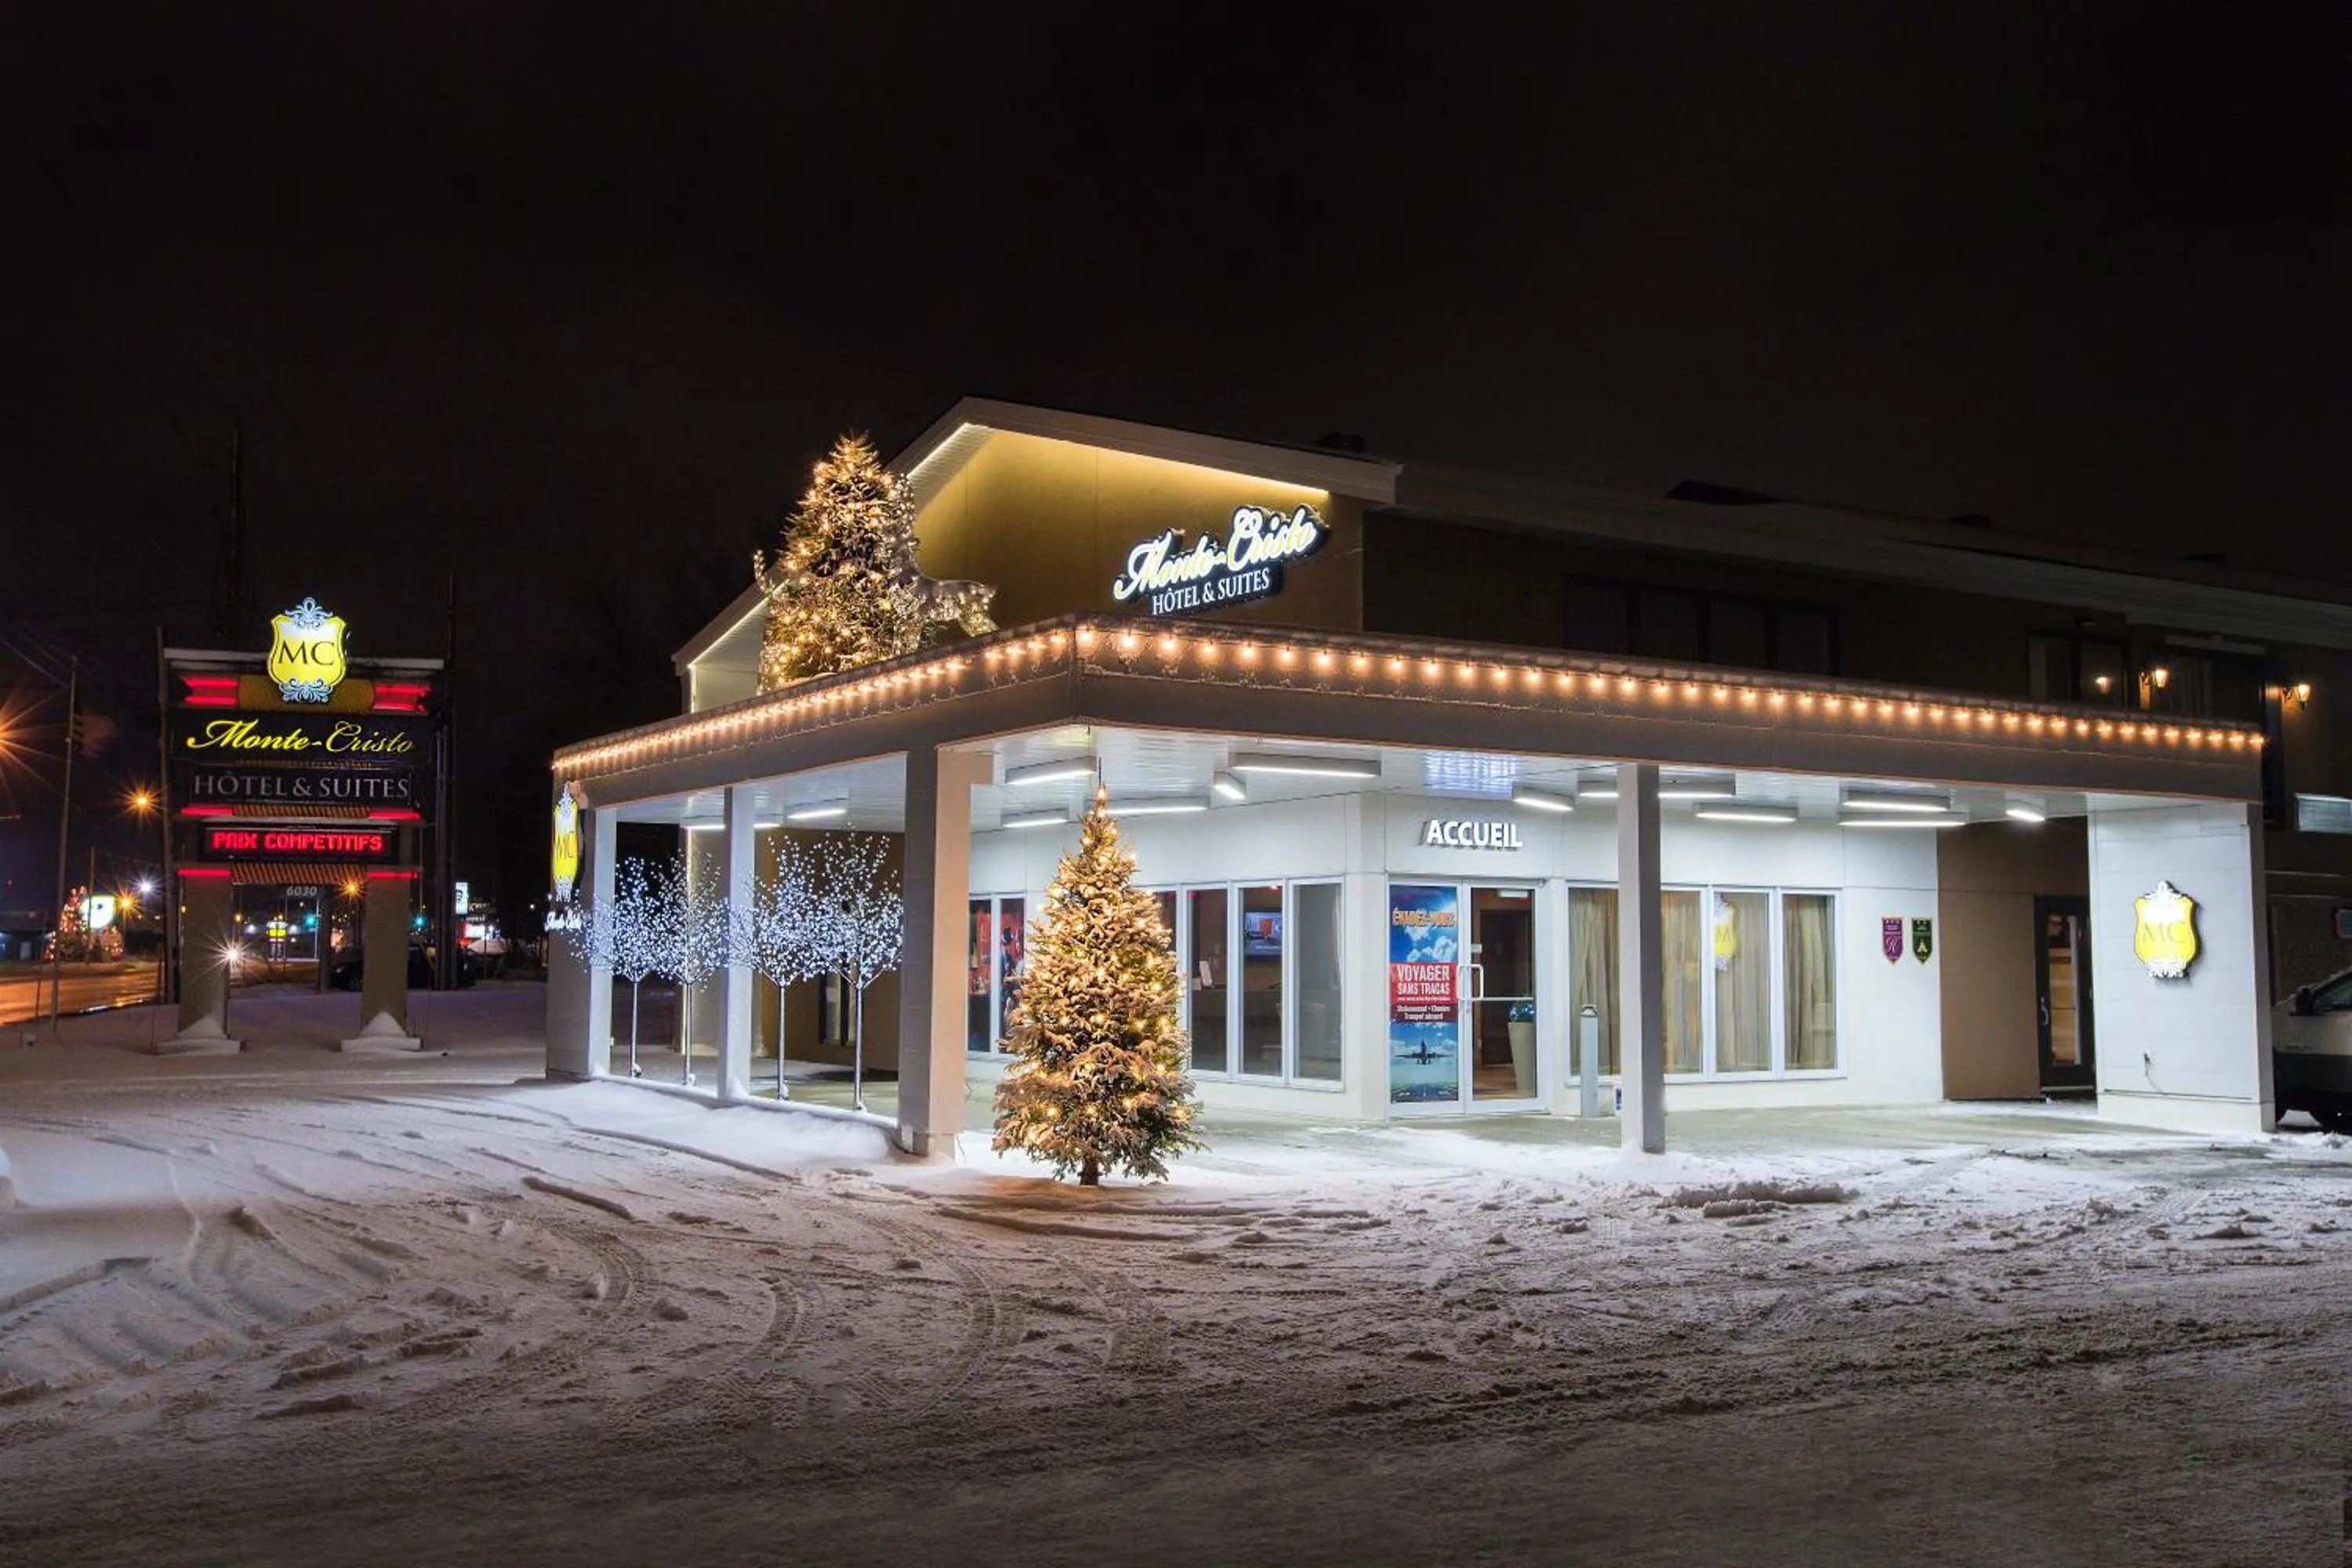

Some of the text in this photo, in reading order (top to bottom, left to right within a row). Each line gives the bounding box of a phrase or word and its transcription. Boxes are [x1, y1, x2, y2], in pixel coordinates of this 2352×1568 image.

[1152, 568, 1270, 615] HÔTEL & SUITES
[278, 641, 336, 666] MC
[186, 719, 415, 753] Monte-Cristo
[193, 771, 409, 799] HÔTEL & SUITES
[212, 831, 384, 852] PRIX COMPETITIFS
[1425, 819, 1523, 848] ACCUEIL
[285, 886, 318, 897] 6030
[2142, 920, 2186, 943] MC
[1396, 964, 1450, 982] VOYAGER
[1397, 982, 1450, 995] SANS TRACAS
